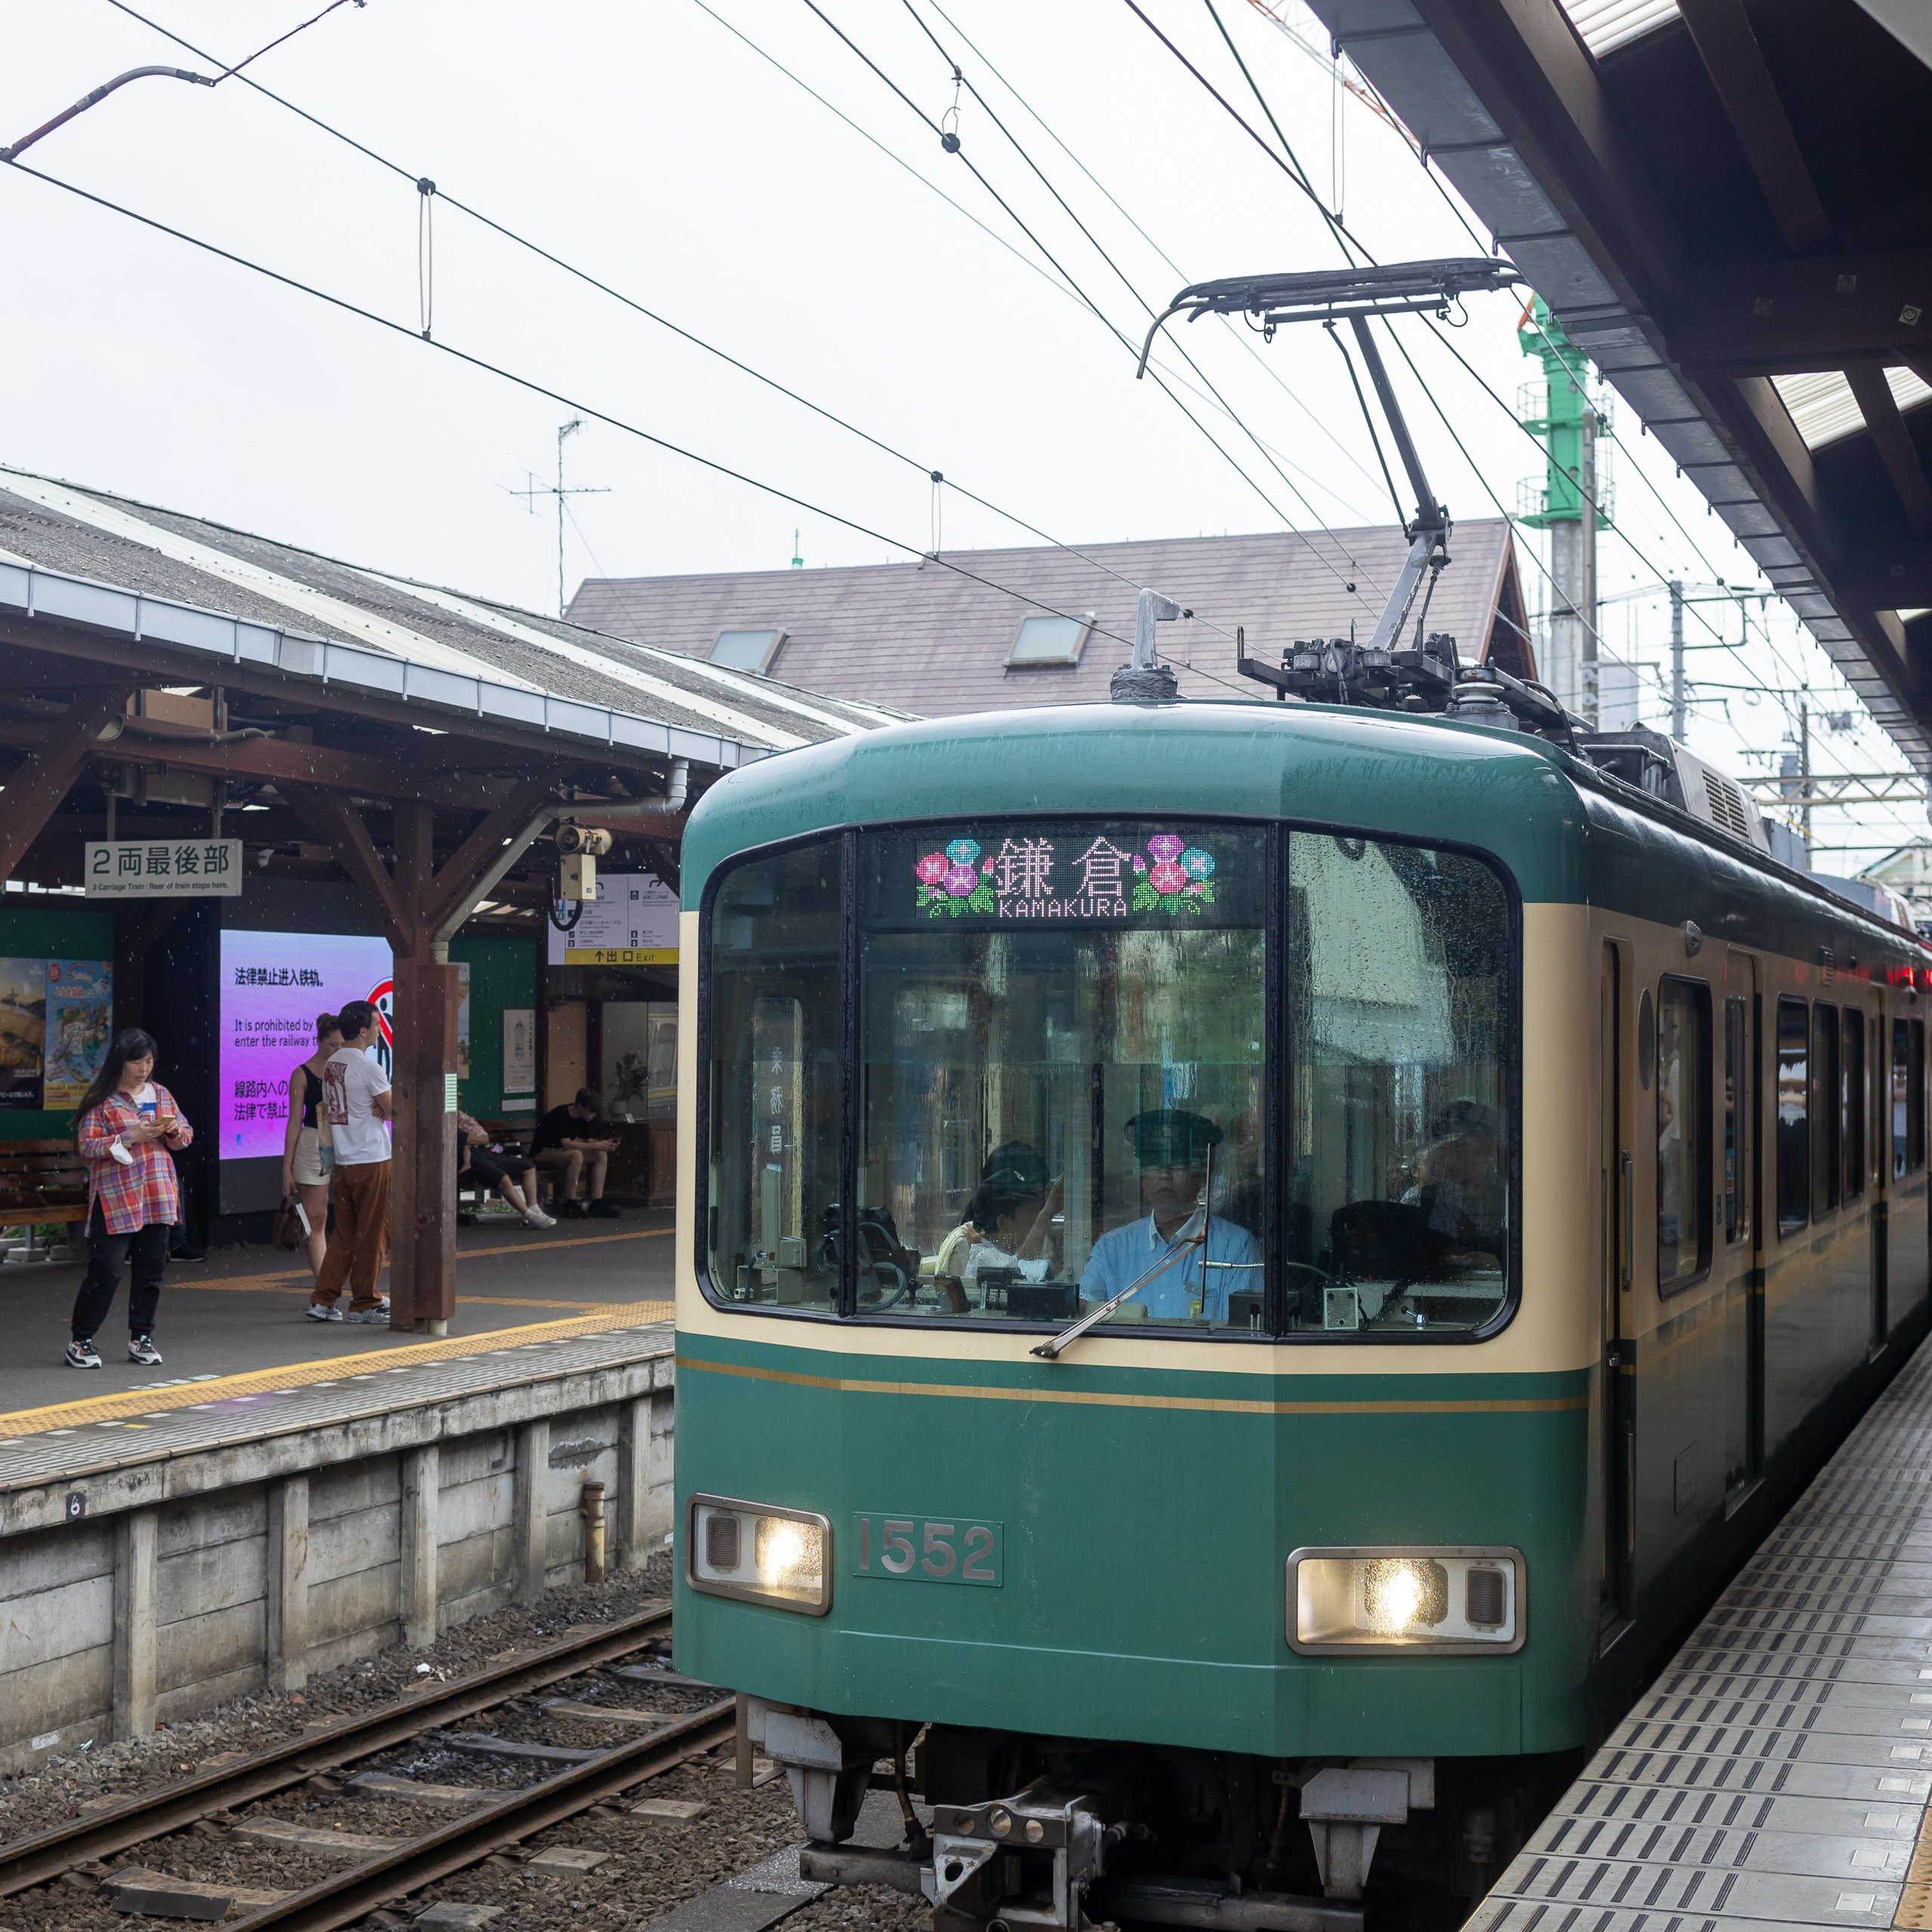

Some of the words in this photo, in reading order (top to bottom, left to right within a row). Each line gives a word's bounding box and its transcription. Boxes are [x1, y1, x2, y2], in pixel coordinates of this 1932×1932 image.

[93, 844, 229, 876] 2両最後部
[995, 835, 1132, 898] 鎌倉
[98, 883, 126, 892] Carriage
[128, 882, 145, 891] Train
[166, 881, 173, 890] of
[191, 881, 211, 890] stops
[999, 898, 1128, 918] KAMAKURA
[607, 951, 633, 962] 出口
[636, 953, 655, 962] Exit
[235, 967, 323, 987] 法律禁止进入铁轨。
[235, 1019, 242, 1031] It
[245, 1019, 252, 1031] is
[254, 1018, 300, 1032] prohibited
[303, 1018, 313, 1032] by
[235, 1036, 259, 1048] enter
[262, 1035, 276, 1047] the
[278, 1034, 310, 1048] railway
[234, 1080, 288, 1098] 線路内への
[234, 1101, 288, 1121] 法律で禁止
[70, 1495, 80, 1515] 6
[860, 1518, 995, 1581] 1552
